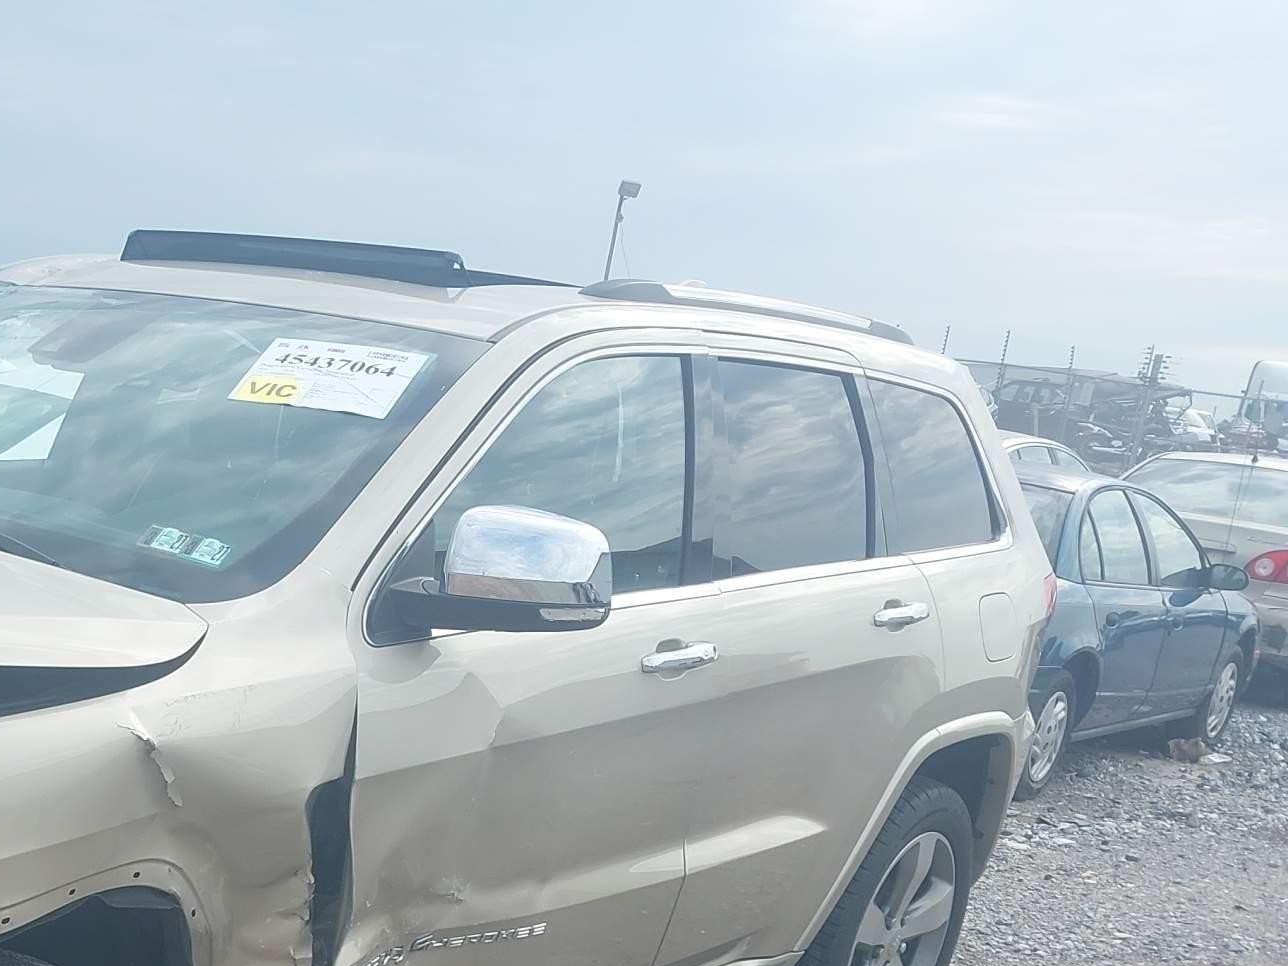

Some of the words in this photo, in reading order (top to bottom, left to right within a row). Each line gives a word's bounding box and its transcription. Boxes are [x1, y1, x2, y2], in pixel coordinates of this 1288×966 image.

[274, 352, 398, 378] 45437064
[249, 381, 298, 398] VIC
[409, 922, 547, 952] CHEROKEE
